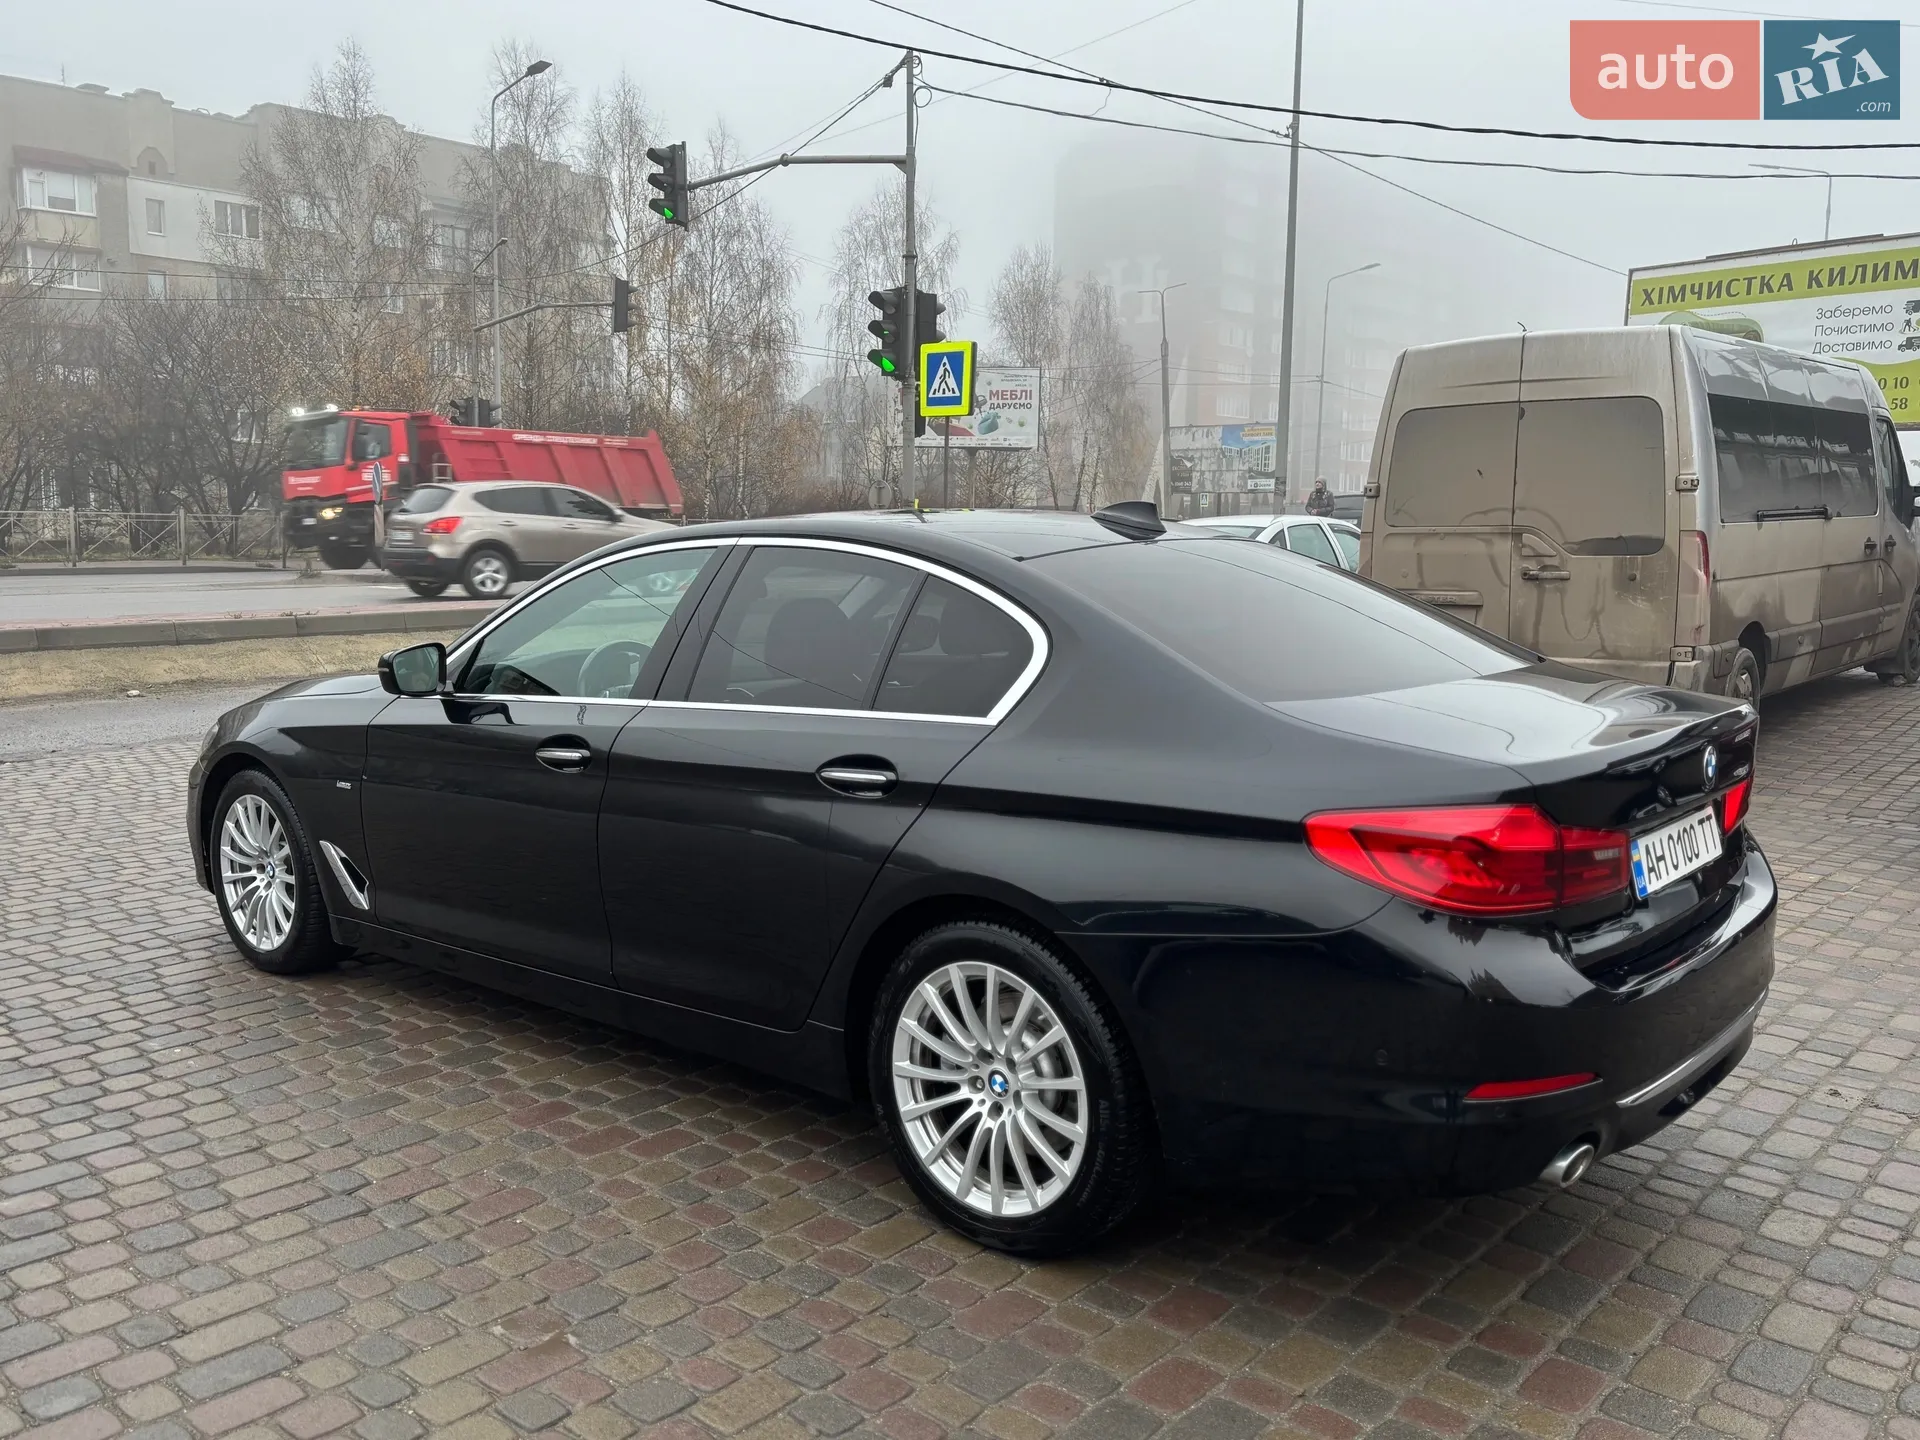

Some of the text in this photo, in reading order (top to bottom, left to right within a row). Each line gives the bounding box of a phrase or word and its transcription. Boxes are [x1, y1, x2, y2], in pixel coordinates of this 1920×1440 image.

[1640, 258, 1920, 307] ХІМЧИСТКА КИЛИМ
[1815, 304, 1893, 320] Заберемо
[1814, 322, 1895, 337] Почистимо
[1812, 340, 1893, 355] Доставимо
[1874, 376, 1910, 391] 0 10
[989, 389, 1032, 401] МЕБЛІ
[989, 402, 1033, 411] ДАРУЄМО
[1890, 397, 1909, 411] 58
[1644, 813, 1717, 885] AH 0100 TT
